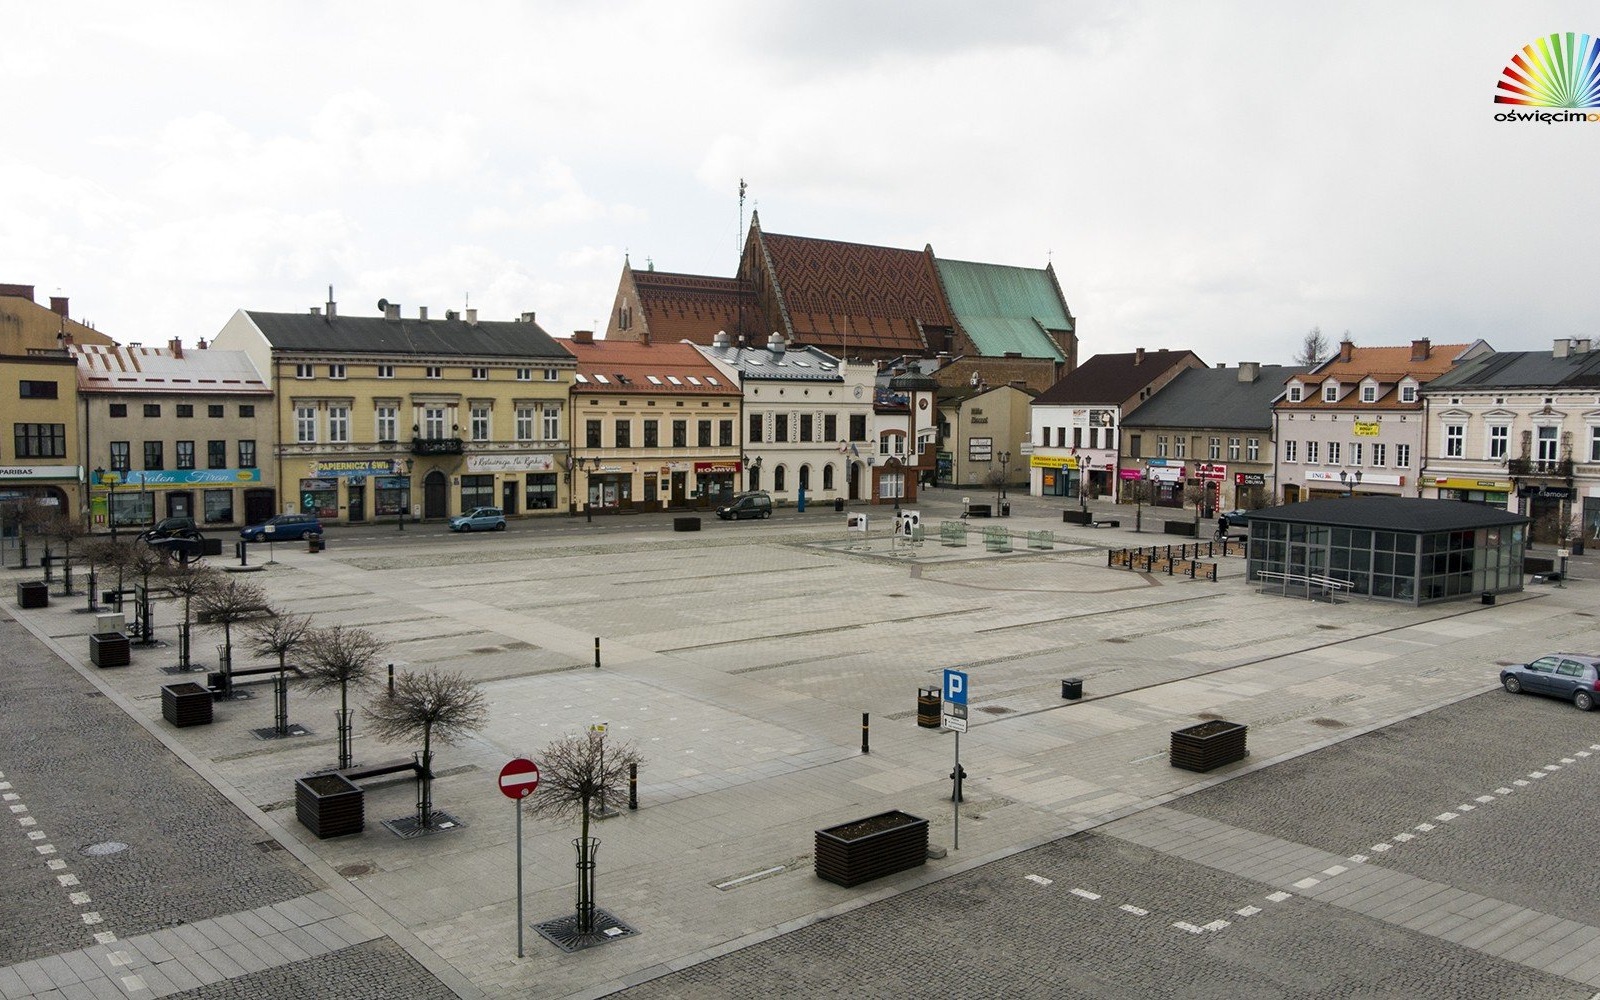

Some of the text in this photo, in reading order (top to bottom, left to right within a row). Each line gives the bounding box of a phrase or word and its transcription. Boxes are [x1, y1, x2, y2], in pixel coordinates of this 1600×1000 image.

[318, 461, 370, 470] PAPIERNICZY
[128, 471, 176, 484] Salon
[1538, 490, 1569, 499] Glamour
[949, 673, 962, 699] P
